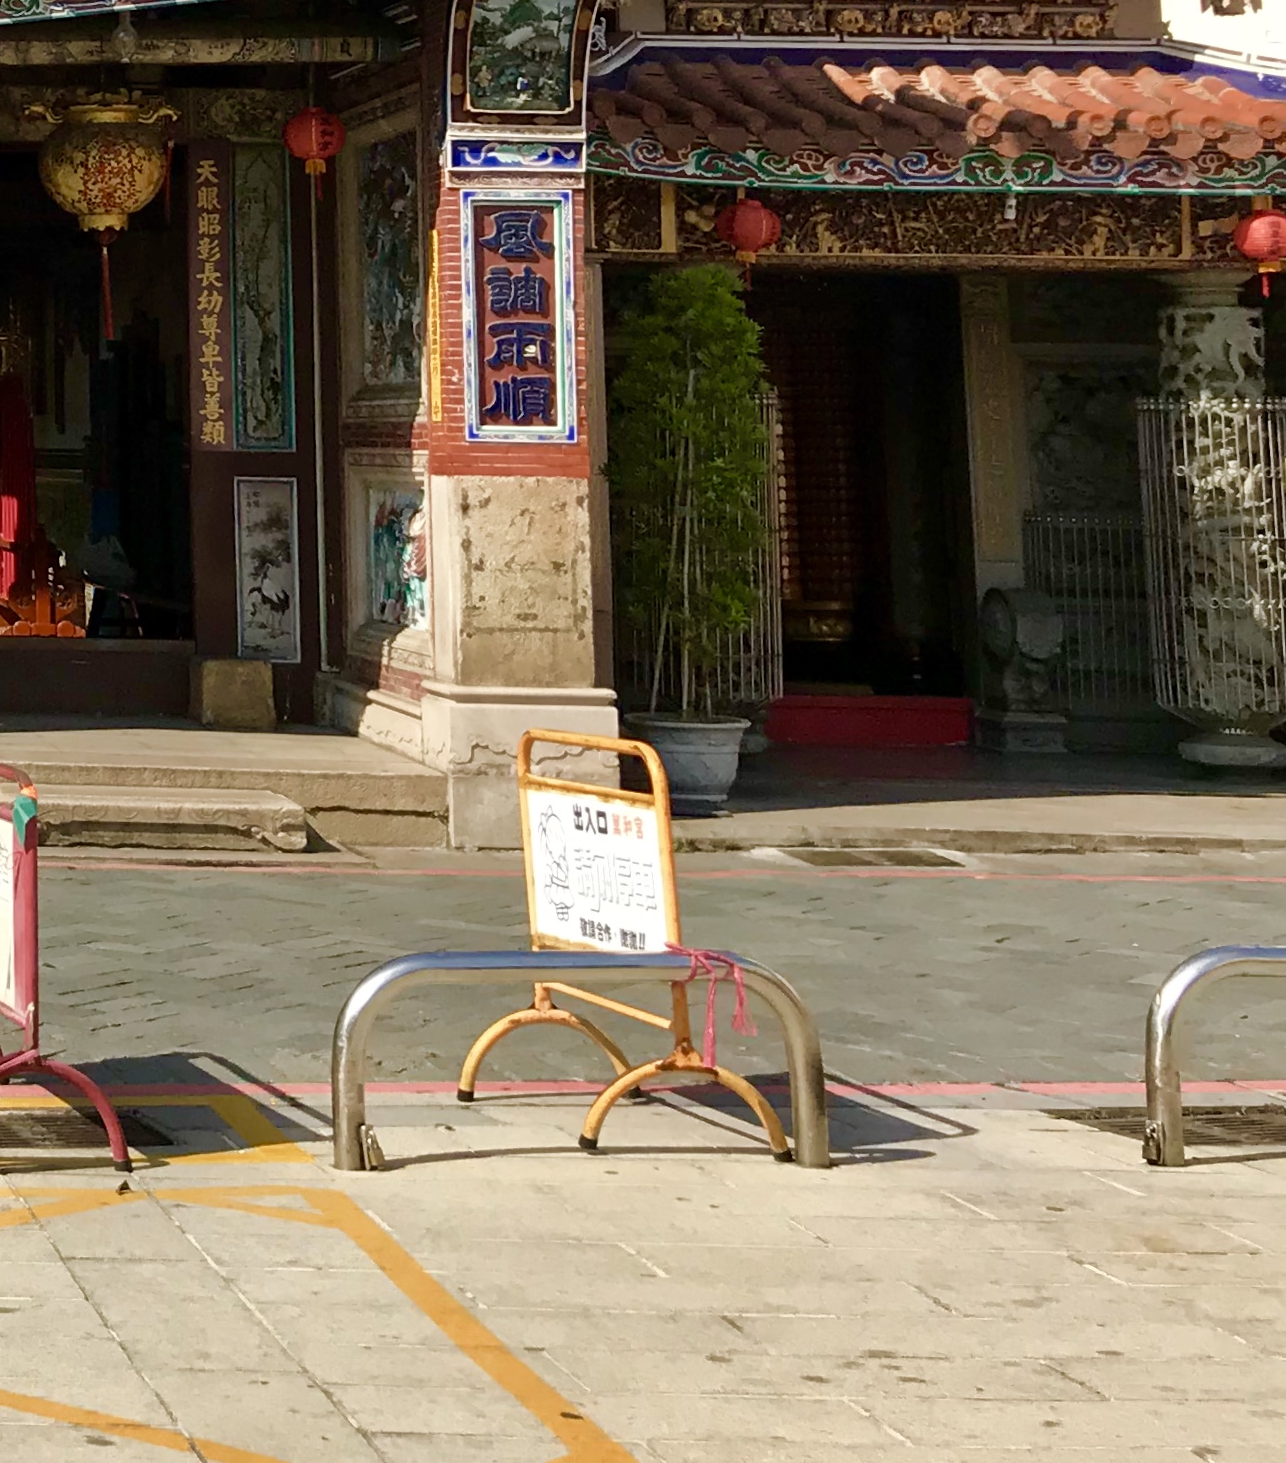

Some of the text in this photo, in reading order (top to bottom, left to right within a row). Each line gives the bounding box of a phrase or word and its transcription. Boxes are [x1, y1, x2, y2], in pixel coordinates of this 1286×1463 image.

[195, 159, 226, 445] 天眼昭彰長幼尊卑皆善類
[479, 211, 554, 421] 風調雨順
[572, 803, 608, 835] 出入口
[573, 847, 657, 913] 請勿停車
